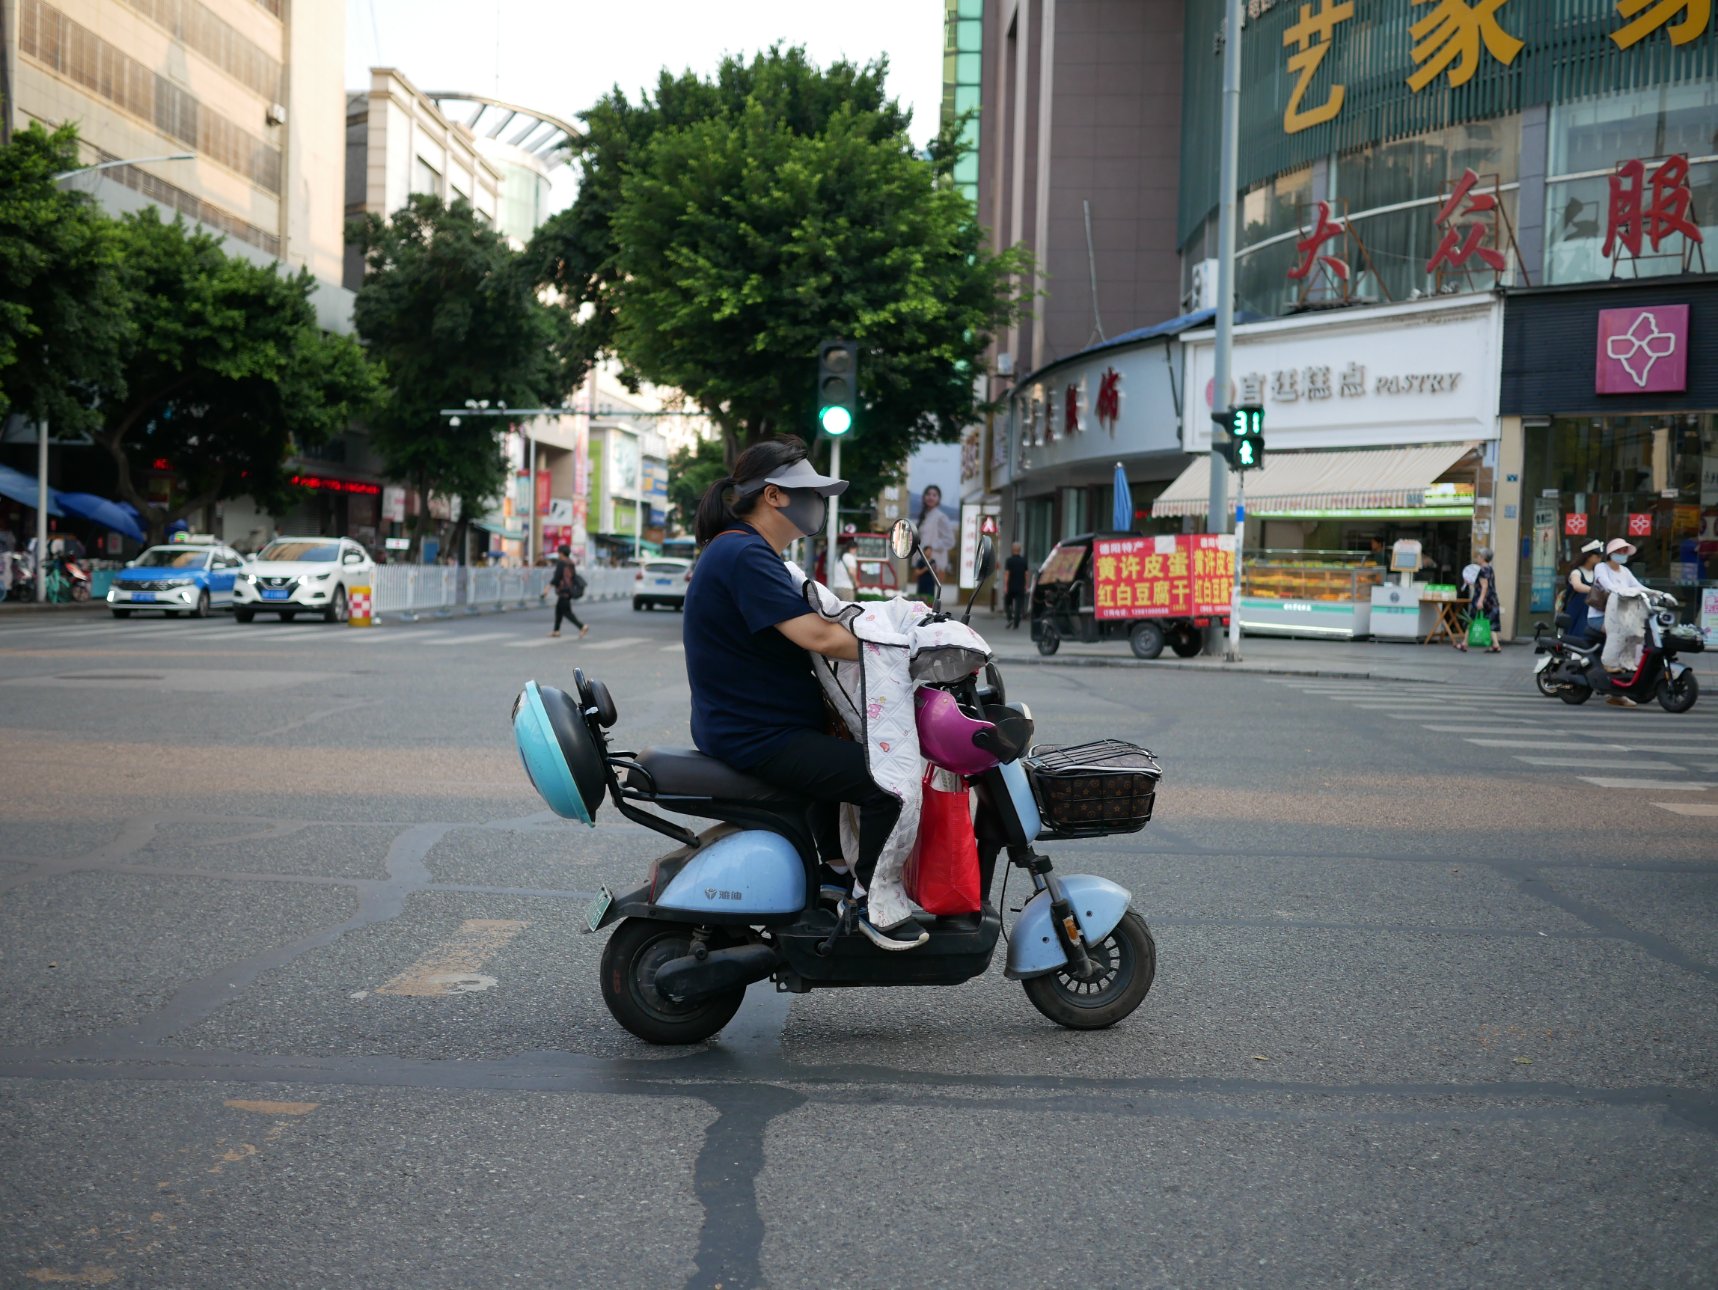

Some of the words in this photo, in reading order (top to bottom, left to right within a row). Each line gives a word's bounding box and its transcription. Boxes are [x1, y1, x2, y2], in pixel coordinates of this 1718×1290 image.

[1375, 372, 1462, 394] PASTRY
[1234, 410, 1260, 435] 31
[1097, 552, 1189, 580] 黄许皮蛋
[1098, 580, 1190, 607] 红白豆腐干
